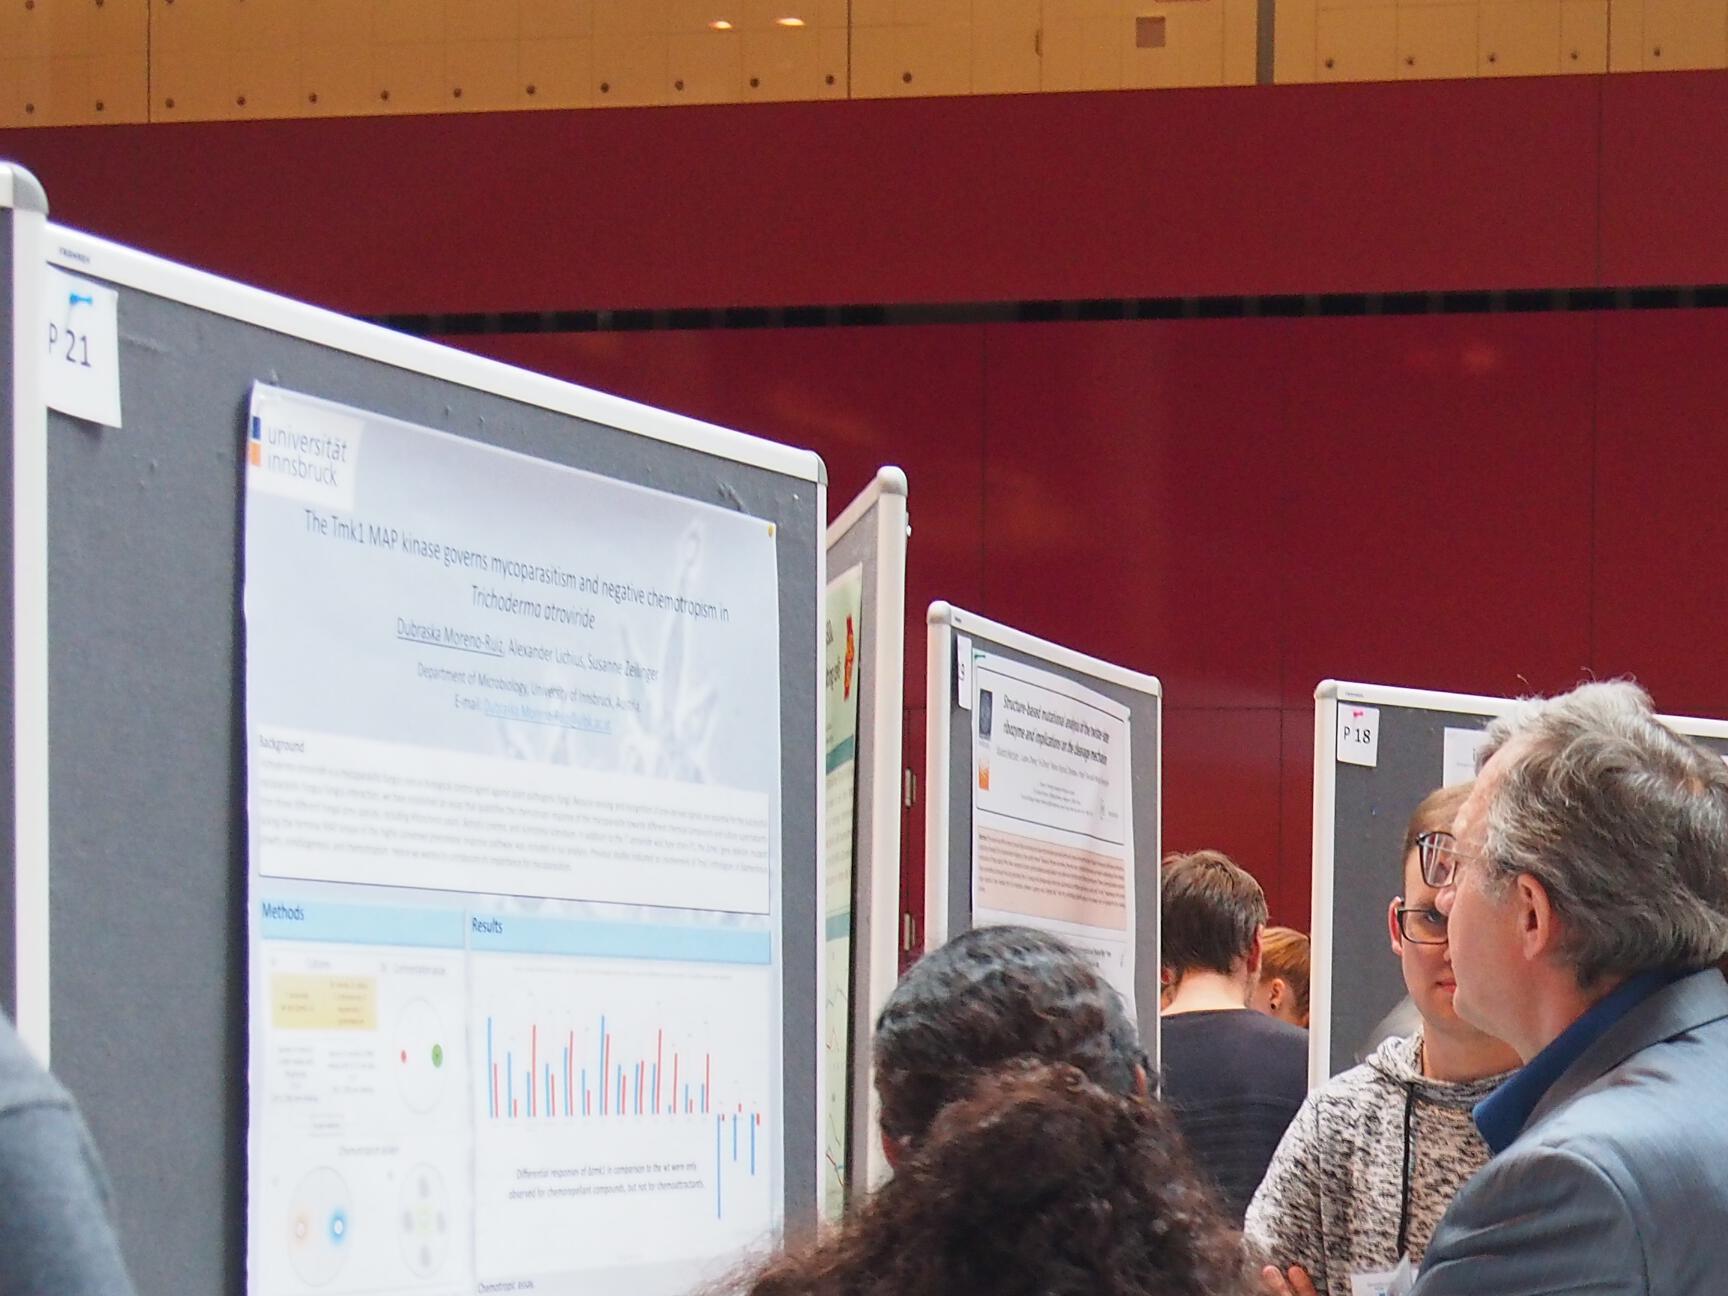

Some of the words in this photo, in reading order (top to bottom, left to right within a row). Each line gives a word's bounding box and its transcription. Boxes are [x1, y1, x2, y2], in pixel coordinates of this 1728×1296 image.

[49, 322, 57, 354] P
[66, 329, 91, 368] 21
[268, 424, 347, 463] universität
[268, 452, 338, 487] innsbruck
[304, 508, 328, 536] The
[332, 515, 365, 544] Tmk1
[369, 525, 398, 551] MAP
[402, 530, 440, 561] kinase
[444, 546, 488, 570] governs
[491, 556, 577, 587] mycoparasitism
[579, 575, 599, 596] and
[602, 582, 645, 606] negative
[646, 588, 718, 623] chemotropism
[718, 606, 730, 623] in
[472, 585, 542, 619] Trichoderma
[544, 604, 596, 630] atroviride
[397, 617, 442, 642] Dubraska
[508, 638, 552, 662] Alexander
[587, 655, 623, 676] Susanne
[1344, 725, 1351, 741] P
[1355, 728, 1371, 745] 18
[262, 902, 305, 922] Methods
[472, 916, 503, 935] Results
